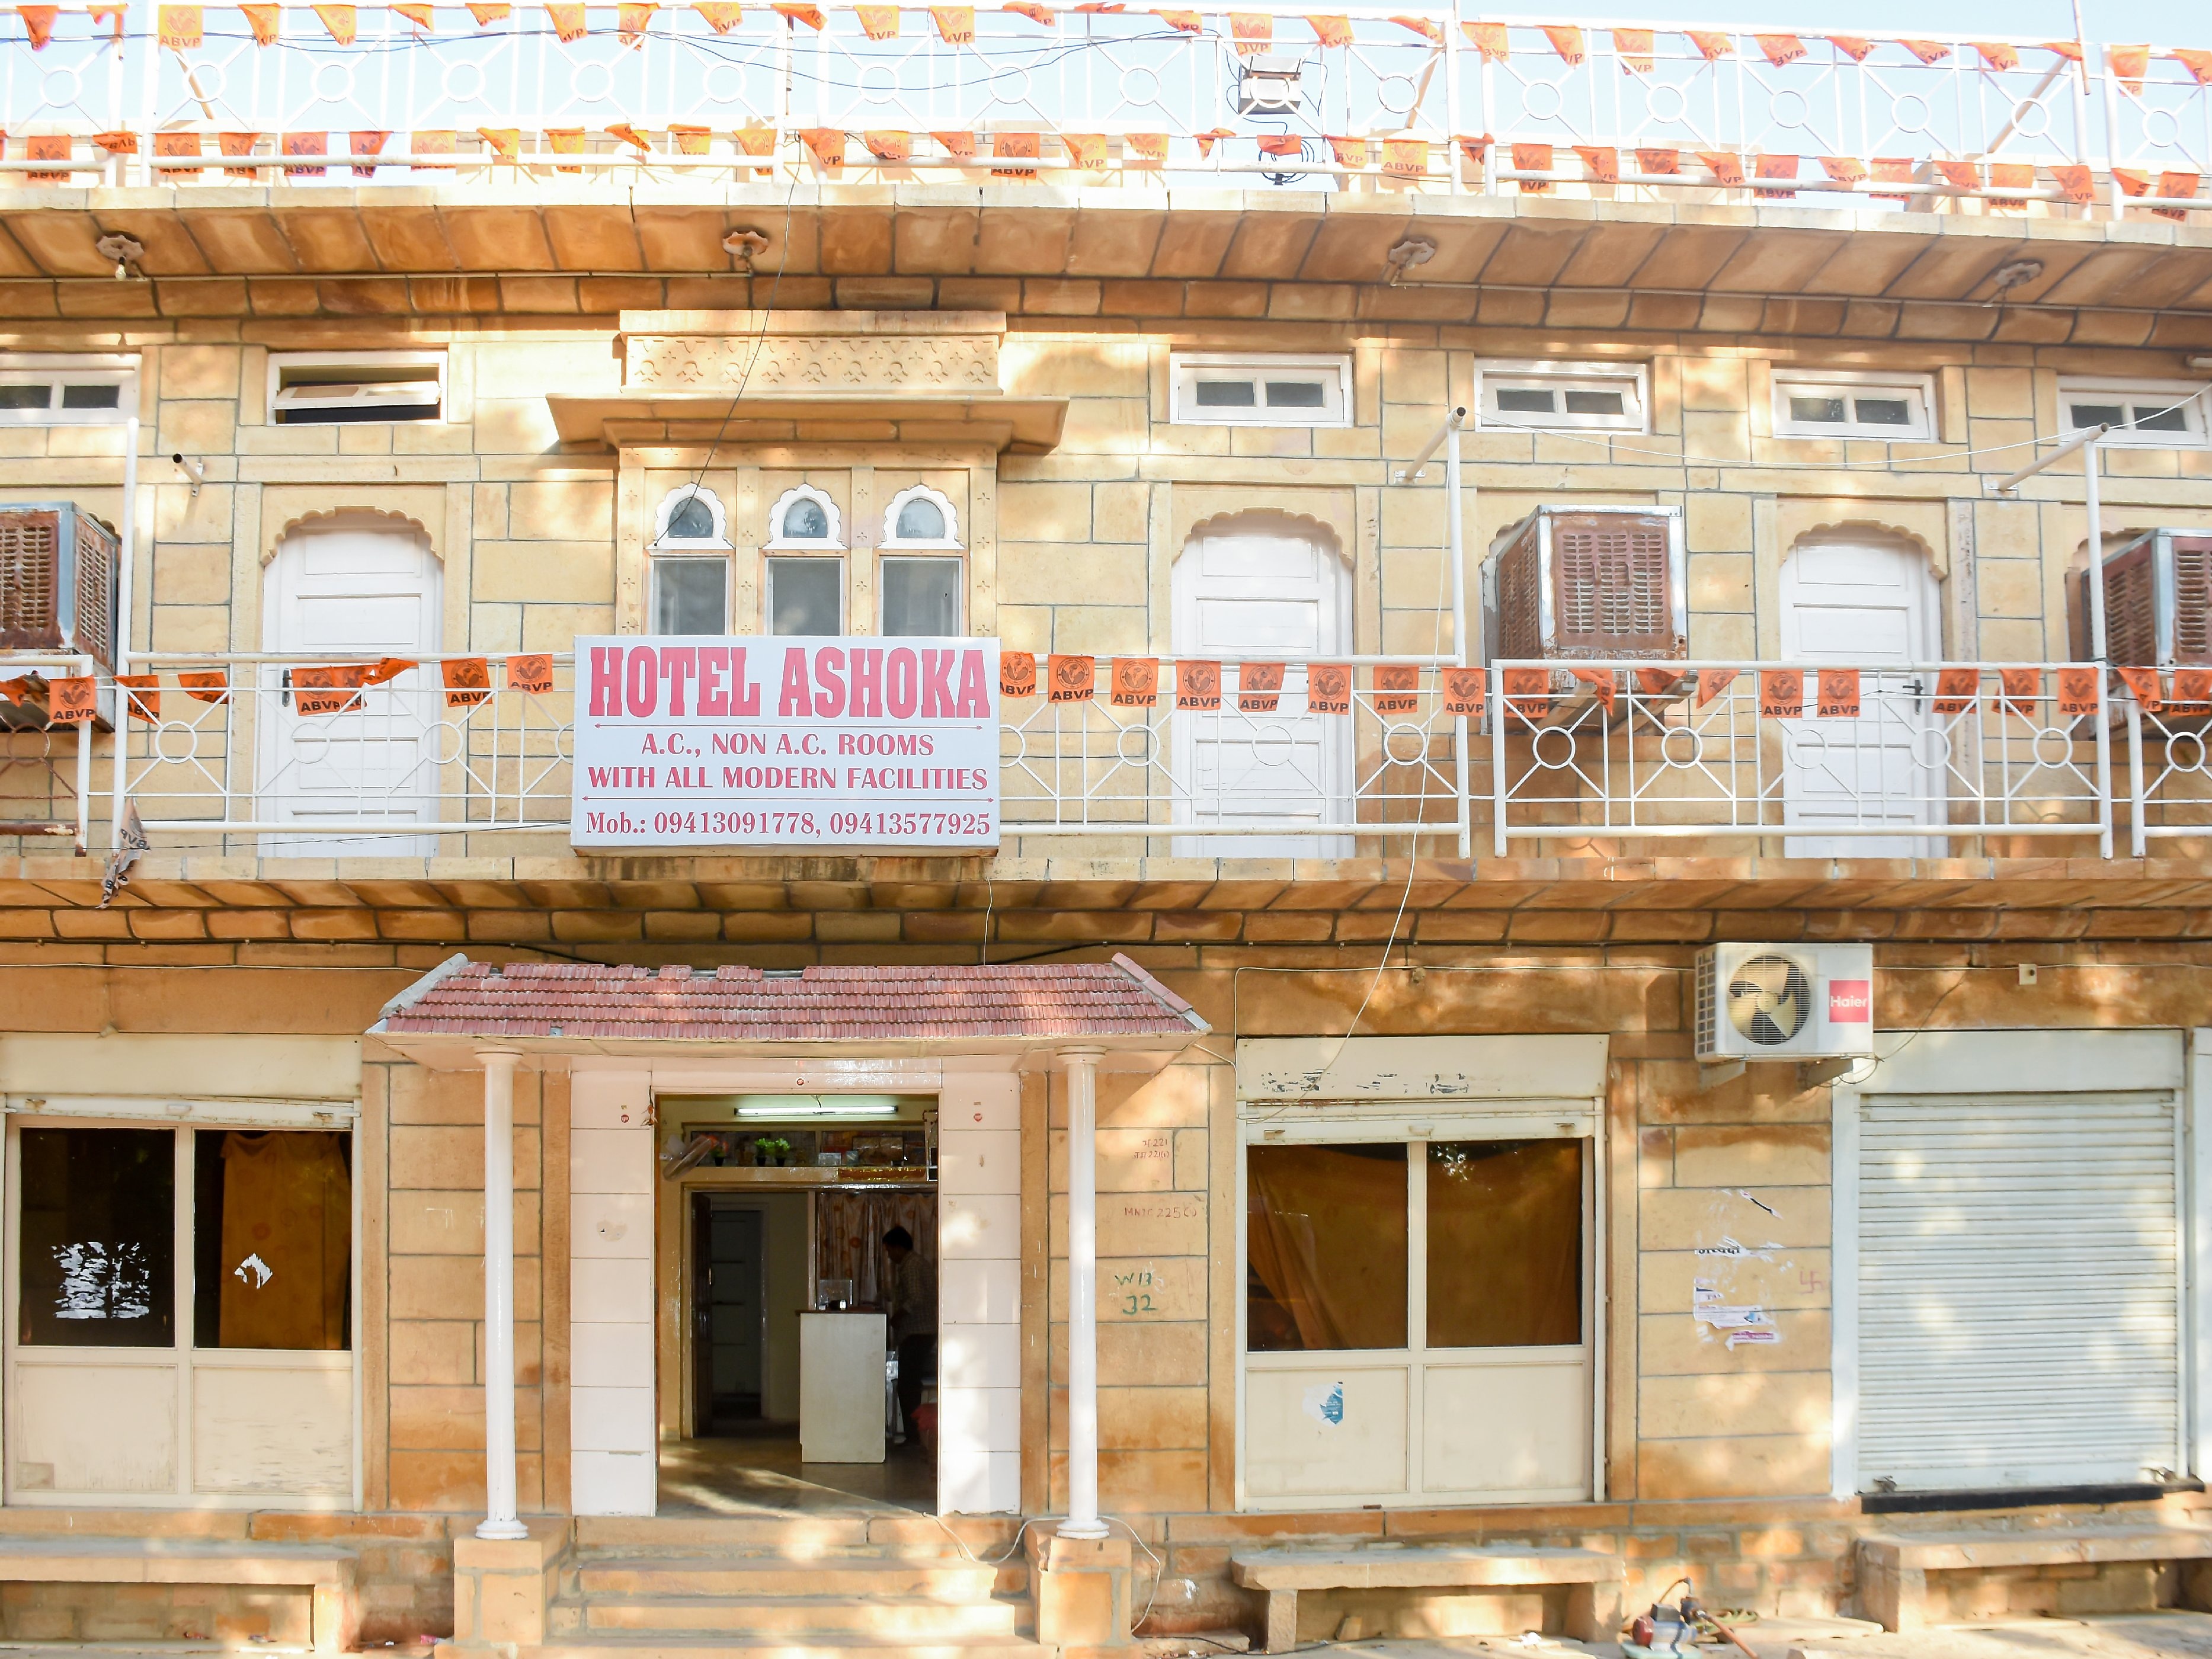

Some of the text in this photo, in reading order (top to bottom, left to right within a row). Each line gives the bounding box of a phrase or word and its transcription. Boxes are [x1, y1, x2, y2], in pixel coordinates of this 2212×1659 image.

[1384, 162, 1424, 172] ABVP
[589, 645, 761, 718] HOTEL
[778, 646, 991, 719] ASHOKA
[1051, 688, 1094, 700] ABVP
[1113, 694, 1157, 704] ABVP
[300, 700, 340, 713] ABVP
[1179, 696, 1220, 707] ABVP
[1240, 700, 1278, 710] ABVP
[1309, 700, 1349, 712] ABVP
[1377, 699, 1417, 710] ABVP
[1446, 702, 1484, 713] ABVP
[1763, 706, 1802, 716] ABVP
[1820, 705, 1859, 715] ABVP
[2060, 703, 2099, 713] ABVP
[54, 709, 95, 720] ABVP
[641, 733, 934, 758] A.C., NON A.C. ROOMS
[588, 767, 988, 790] WITH ALL MODERN FACILITIES
[585, 811, 991, 838] Mob.: 09413091778, 09413577925
[1830, 995, 1867, 1008] Haier
